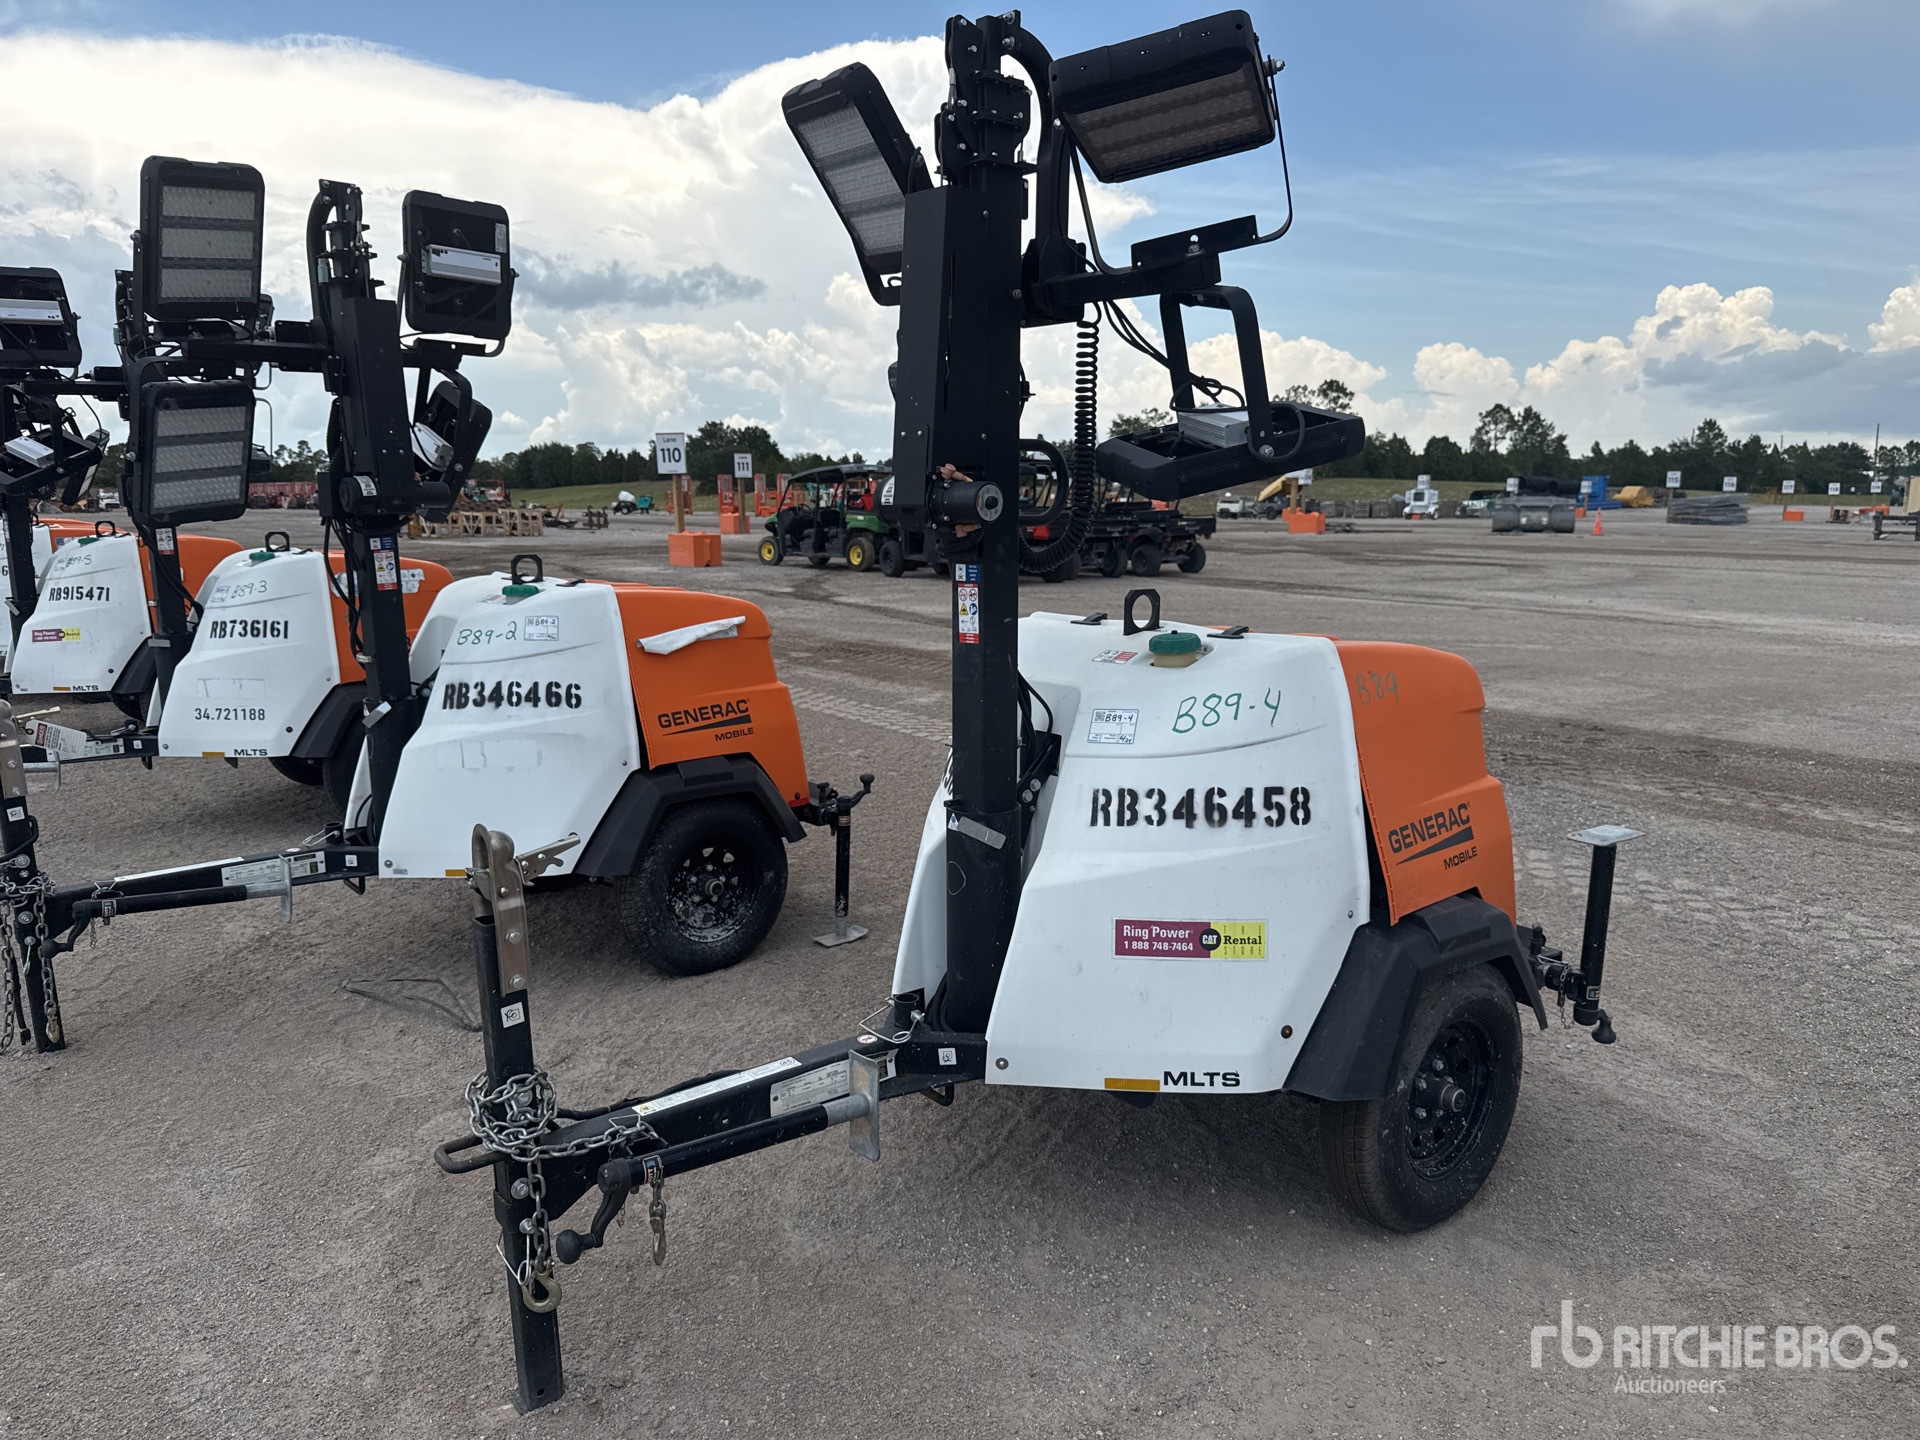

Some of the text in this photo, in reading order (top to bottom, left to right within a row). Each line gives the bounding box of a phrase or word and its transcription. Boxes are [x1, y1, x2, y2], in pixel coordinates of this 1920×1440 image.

[660, 448, 681, 463] 110
[737, 462, 749, 471] 111
[48, 586, 110, 601] RB915471
[210, 619, 289, 639] RB736161
[457, 621, 517, 645] B89-2
[442, 680, 582, 709] RB346466
[195, 708, 265, 720] 34.721188
[658, 699, 749, 728] GENERAC
[1172, 687, 1281, 733] B89-4
[715, 727, 754, 741] MOBILE
[1090, 787, 1311, 828] RB346458
[1388, 802, 1471, 854] GENERAC
[1443, 846, 1478, 870] MOBILE
[1123, 925, 1190, 939] Ring Power
[1202, 935, 1217, 944] CAT
[1223, 935, 1262, 945] Rental
[1124, 941, 1193, 951] 1 888 748-7464
[1164, 1070, 1240, 1087] MLTS
